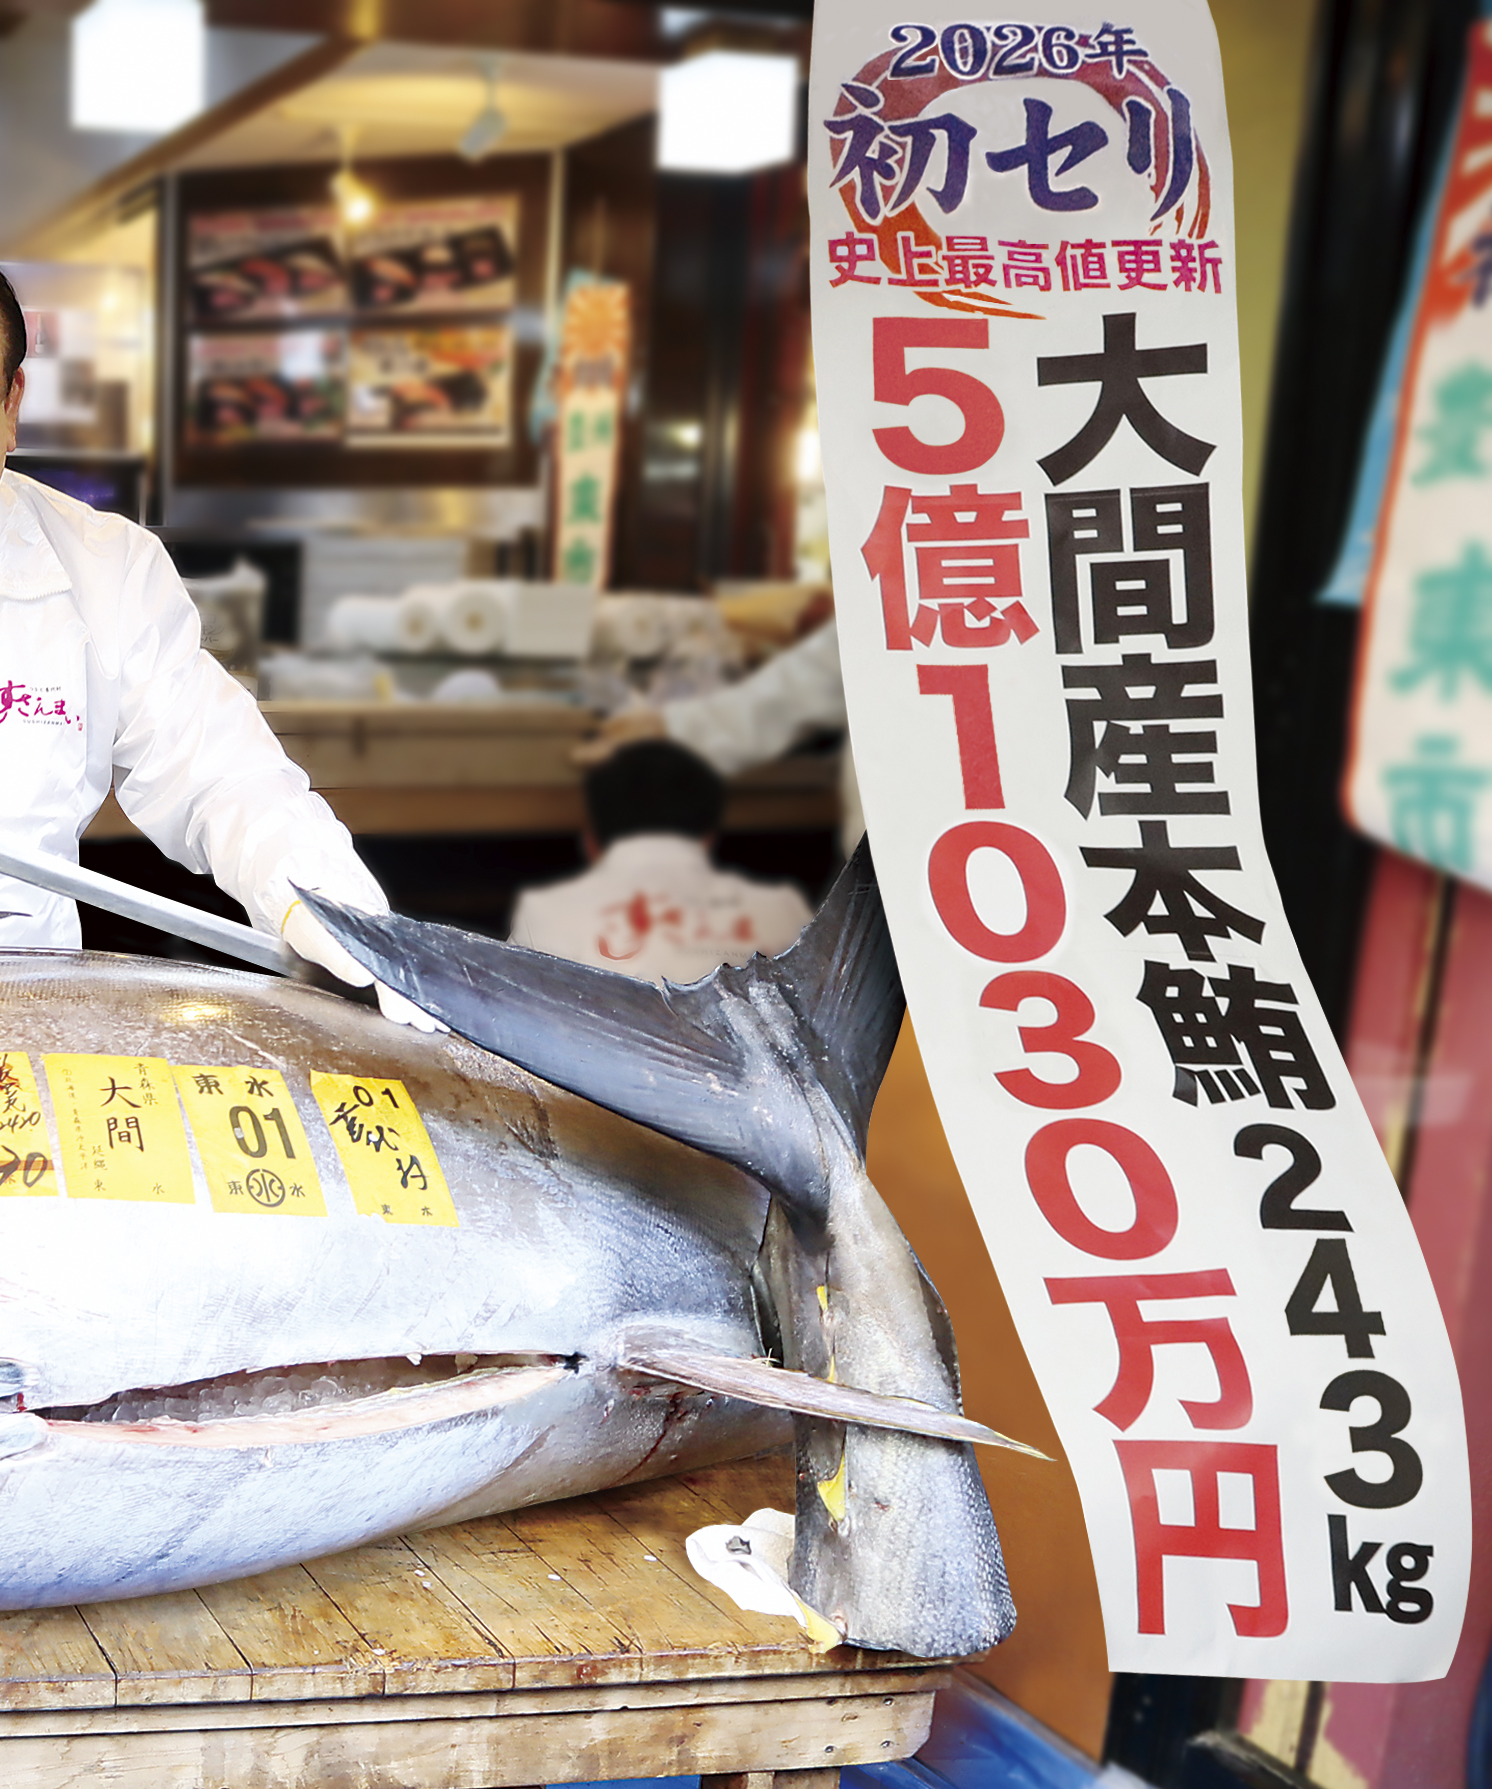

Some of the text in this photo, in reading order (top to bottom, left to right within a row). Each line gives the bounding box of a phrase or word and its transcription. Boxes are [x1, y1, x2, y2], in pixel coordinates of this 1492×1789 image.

[889, 22, 1149, 79] 2026年
[823, 82, 1194, 221] 初セリ
[827, 231, 1224, 294] 史上最高値更新
[861, 316, 1289, 1638] 5億1030万円
[133, 1063, 159, 1106] 青森県
[191, 1072, 275, 1098] 東水
[352, 1085, 400, 1109] 01
[99, 1075, 145, 1153] 大間
[228, 1105, 297, 1160] 01
